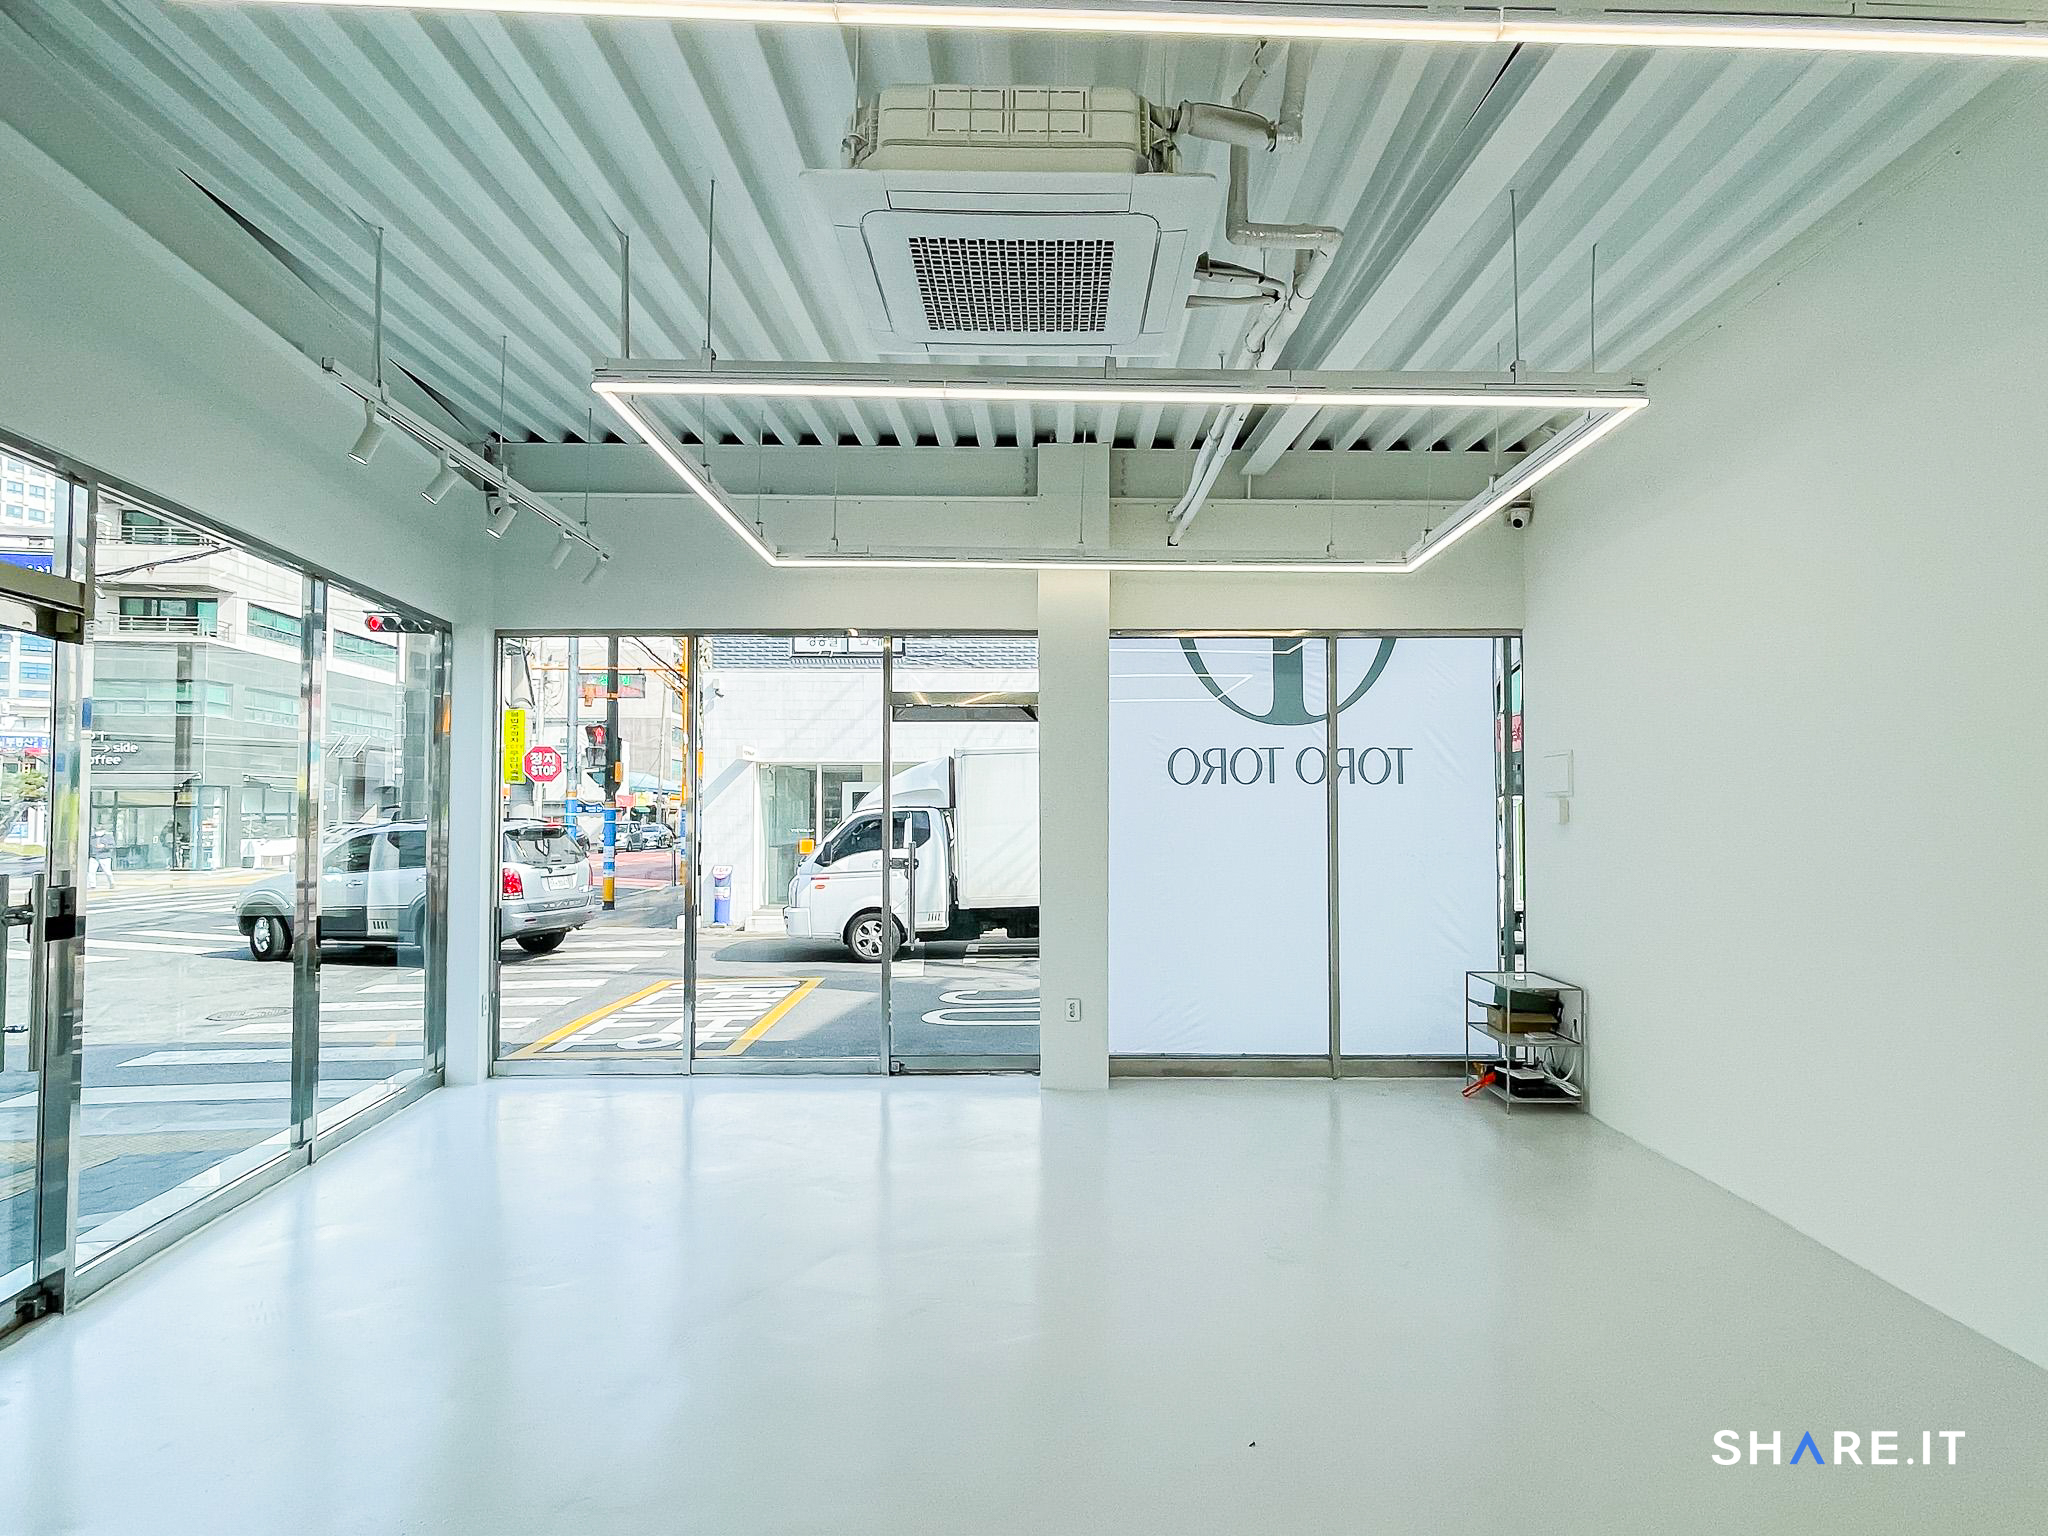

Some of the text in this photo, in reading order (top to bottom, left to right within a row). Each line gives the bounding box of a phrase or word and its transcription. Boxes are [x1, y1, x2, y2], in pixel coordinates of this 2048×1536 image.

[113, 742, 138, 753] side
[530, 752, 556, 765] 정지
[530, 765, 557, 776] STOP
